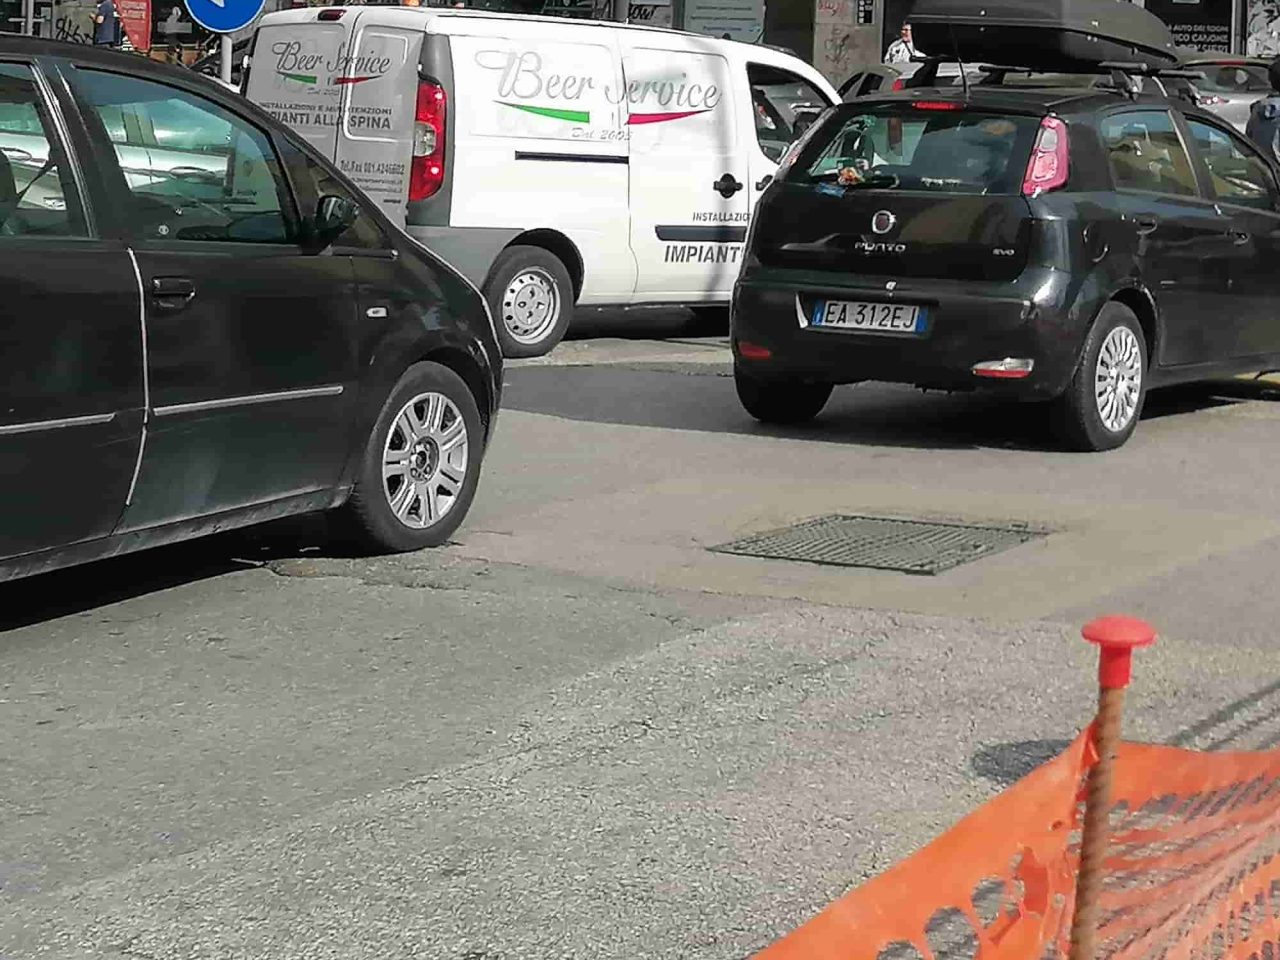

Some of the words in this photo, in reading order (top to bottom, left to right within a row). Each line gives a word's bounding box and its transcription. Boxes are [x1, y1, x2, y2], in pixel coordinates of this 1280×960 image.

[272, 41, 323, 71] Beer
[326, 41, 392, 73] Service
[474, 51, 594, 101] Beer
[604, 57, 722, 109] Service
[350, 115, 391, 130] SPINA
[825, 303, 849, 324] EA
[855, 304, 918, 329] 312EJ
